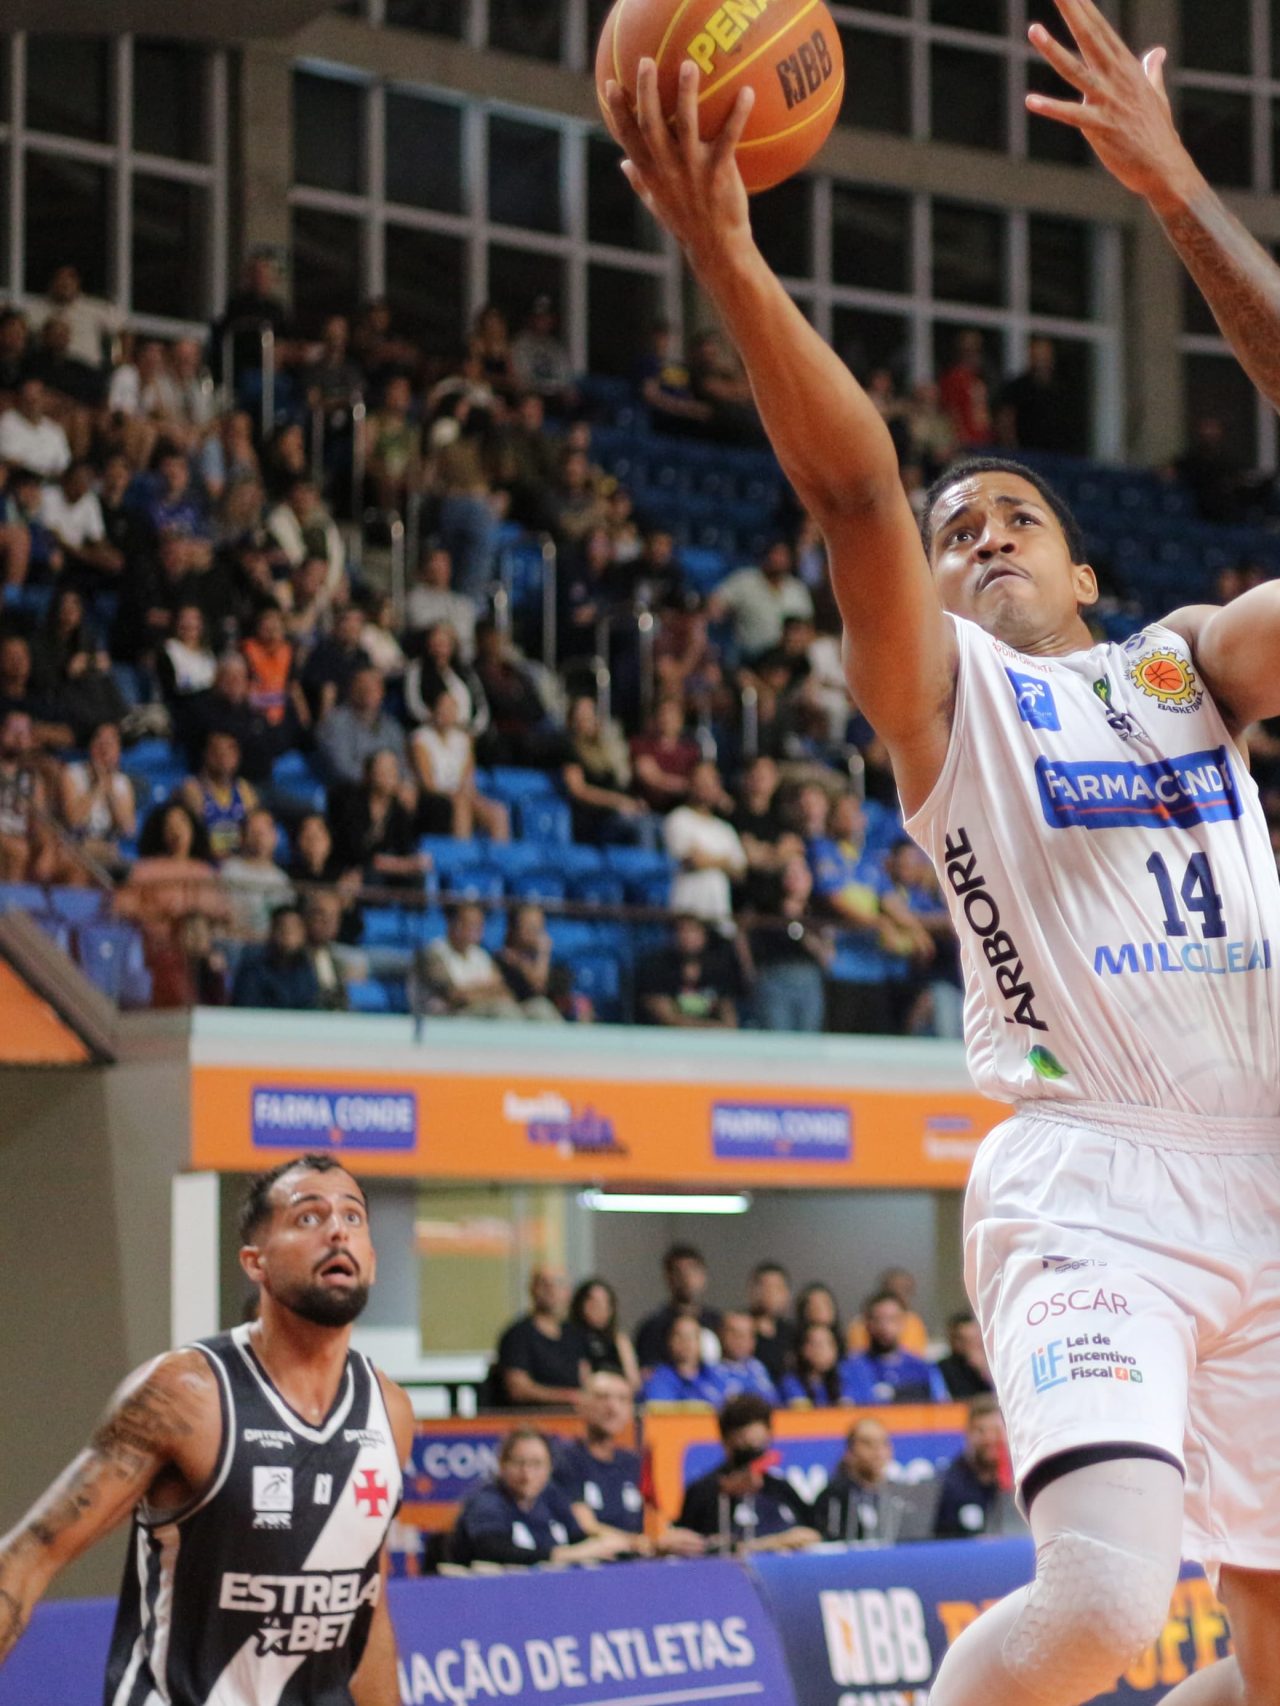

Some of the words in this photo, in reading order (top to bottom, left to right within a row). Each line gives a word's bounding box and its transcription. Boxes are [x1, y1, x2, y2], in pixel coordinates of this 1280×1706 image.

[1145, 851, 1228, 939] 14
[945, 827, 1049, 1032] ÁRBORE
[1026, 1288, 1133, 1326] OSCAR
[1066, 1333, 1089, 1348] Lei
[1092, 1332, 1111, 1346] de
[1068, 1350, 1137, 1366] Incentivo
[1070, 1365, 1113, 1381] Fiscal
[218, 1572, 381, 1614] ESTRELA
[287, 1613, 356, 1653] BET
[818, 1587, 932, 1686] NBB
[398, 1638, 523, 1706] AÇÃO
[525, 1634, 587, 1691] DE
[589, 1616, 755, 1683] ATLETAS
